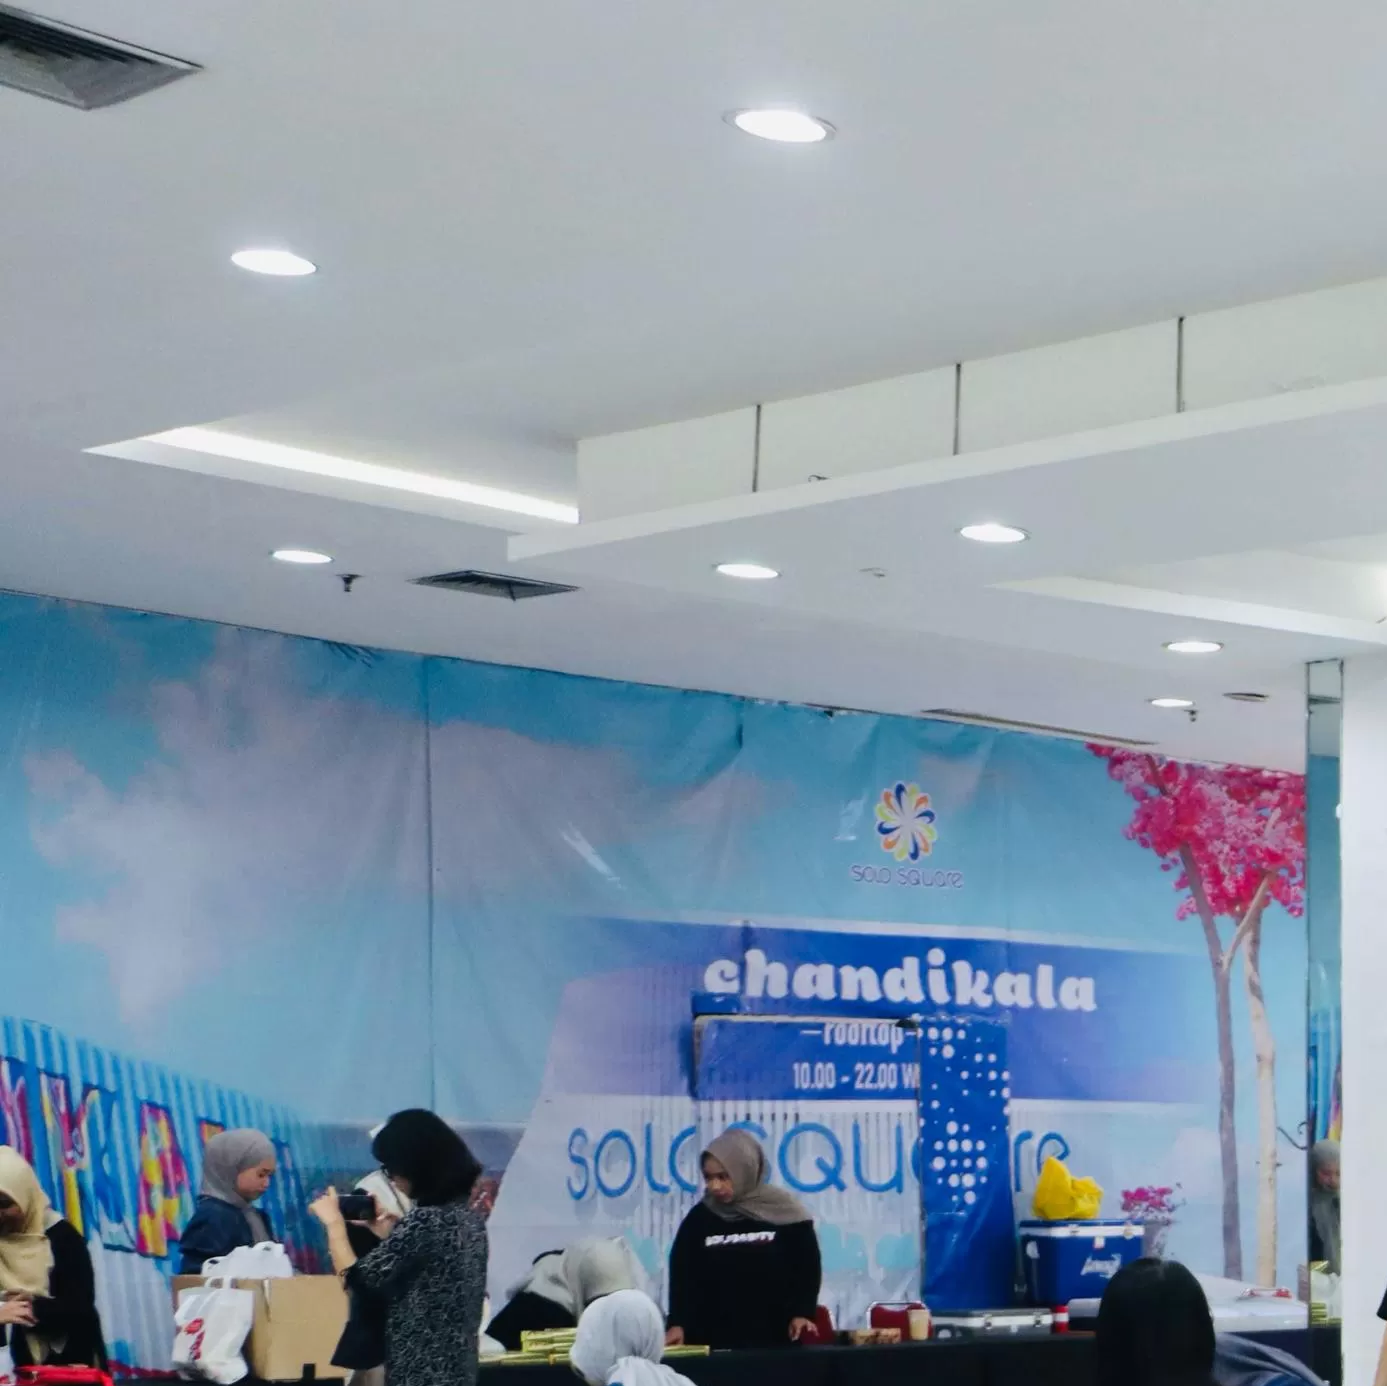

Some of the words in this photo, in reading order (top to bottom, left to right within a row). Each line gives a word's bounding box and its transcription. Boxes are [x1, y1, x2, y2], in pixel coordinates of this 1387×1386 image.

[703, 948, 1098, 1012] chandikala
[793, 1062, 836, 1089] 10.00
[854, 1062, 898, 1090] 22.00
